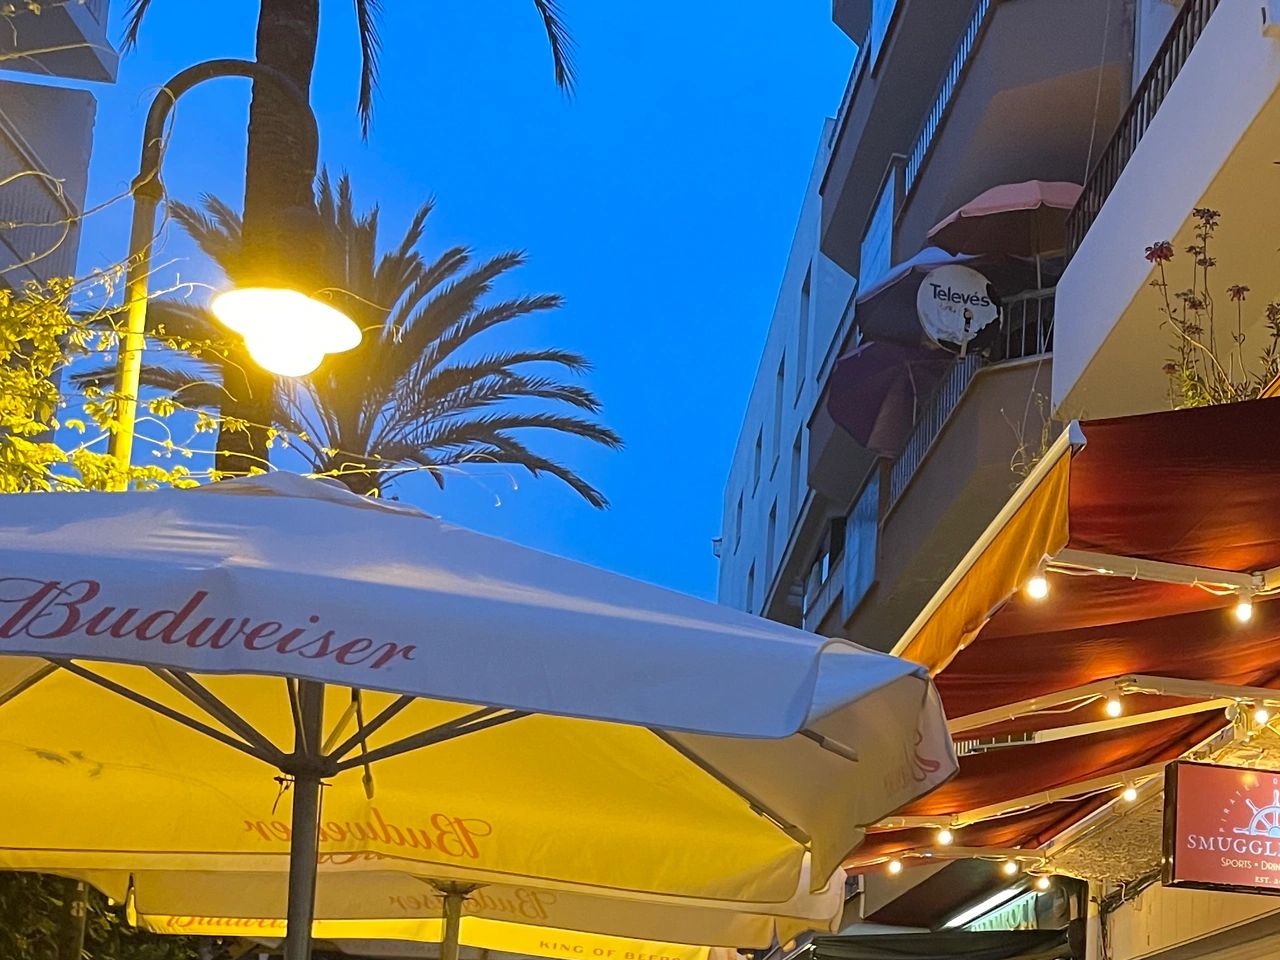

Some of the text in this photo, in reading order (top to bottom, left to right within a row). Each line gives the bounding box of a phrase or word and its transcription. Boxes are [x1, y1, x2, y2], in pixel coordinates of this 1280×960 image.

[930, 282, 990, 307] Televés
[0, 577, 416, 670] Budweiser
[1221, 857, 1252, 870] SPORTS
[539, 940, 584, 954] KING
[593, 947, 617, 958] OF
